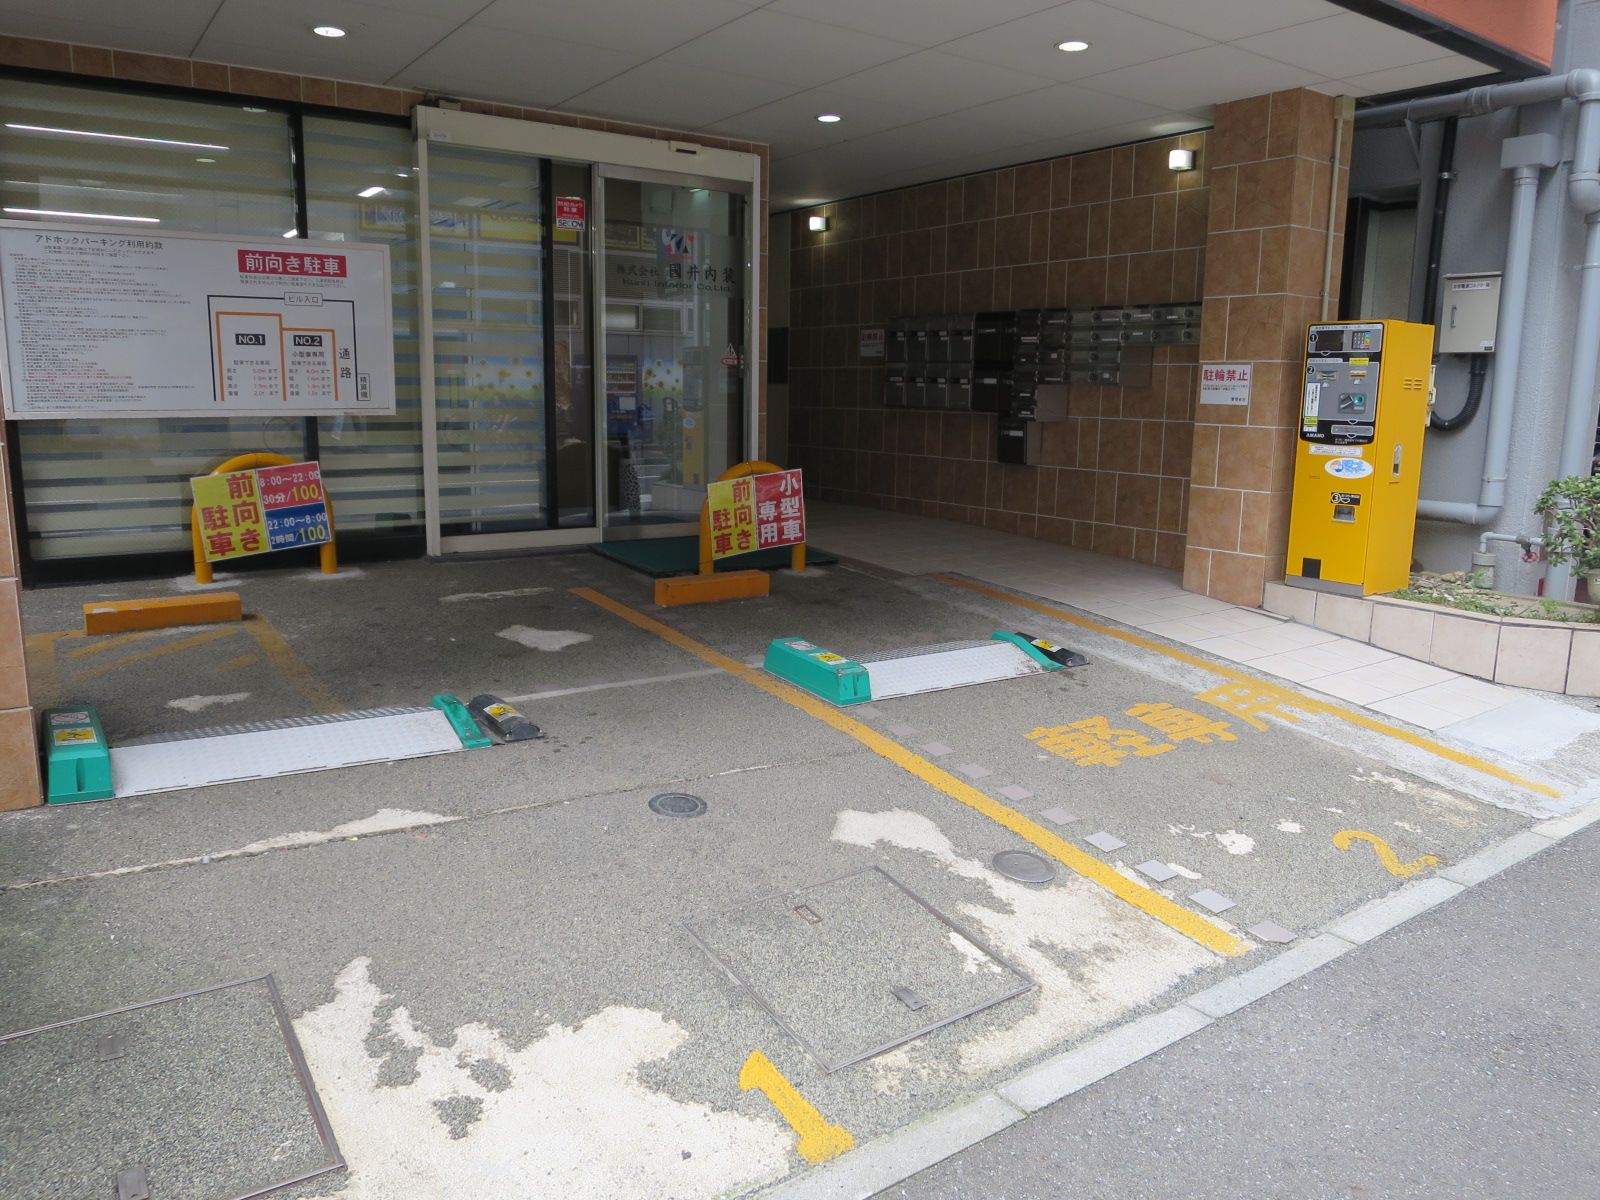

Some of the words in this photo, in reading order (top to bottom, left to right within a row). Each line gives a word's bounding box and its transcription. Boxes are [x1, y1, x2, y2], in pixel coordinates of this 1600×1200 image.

[558, 219, 584, 228] SECOM
[245, 253, 340, 275] 前向き駐車
[288, 295, 319, 304] ビル入口
[238, 335, 264, 345] NO.1
[295, 336, 322, 346] NO.2
[339, 347, 352, 379] 通路
[1203, 369, 1248, 381] 駐輪禁止
[226, 473, 260, 552] 前向き
[732, 479, 752, 550] 前向き
[759, 500, 778, 544] 専用
[780, 474, 802, 540] 小型車
[202, 505, 236, 556] 駐車
[712, 508, 733, 554] 駐車
[1332, 830, 1440, 878] 2
[738, 1049, 855, 1167] 1
